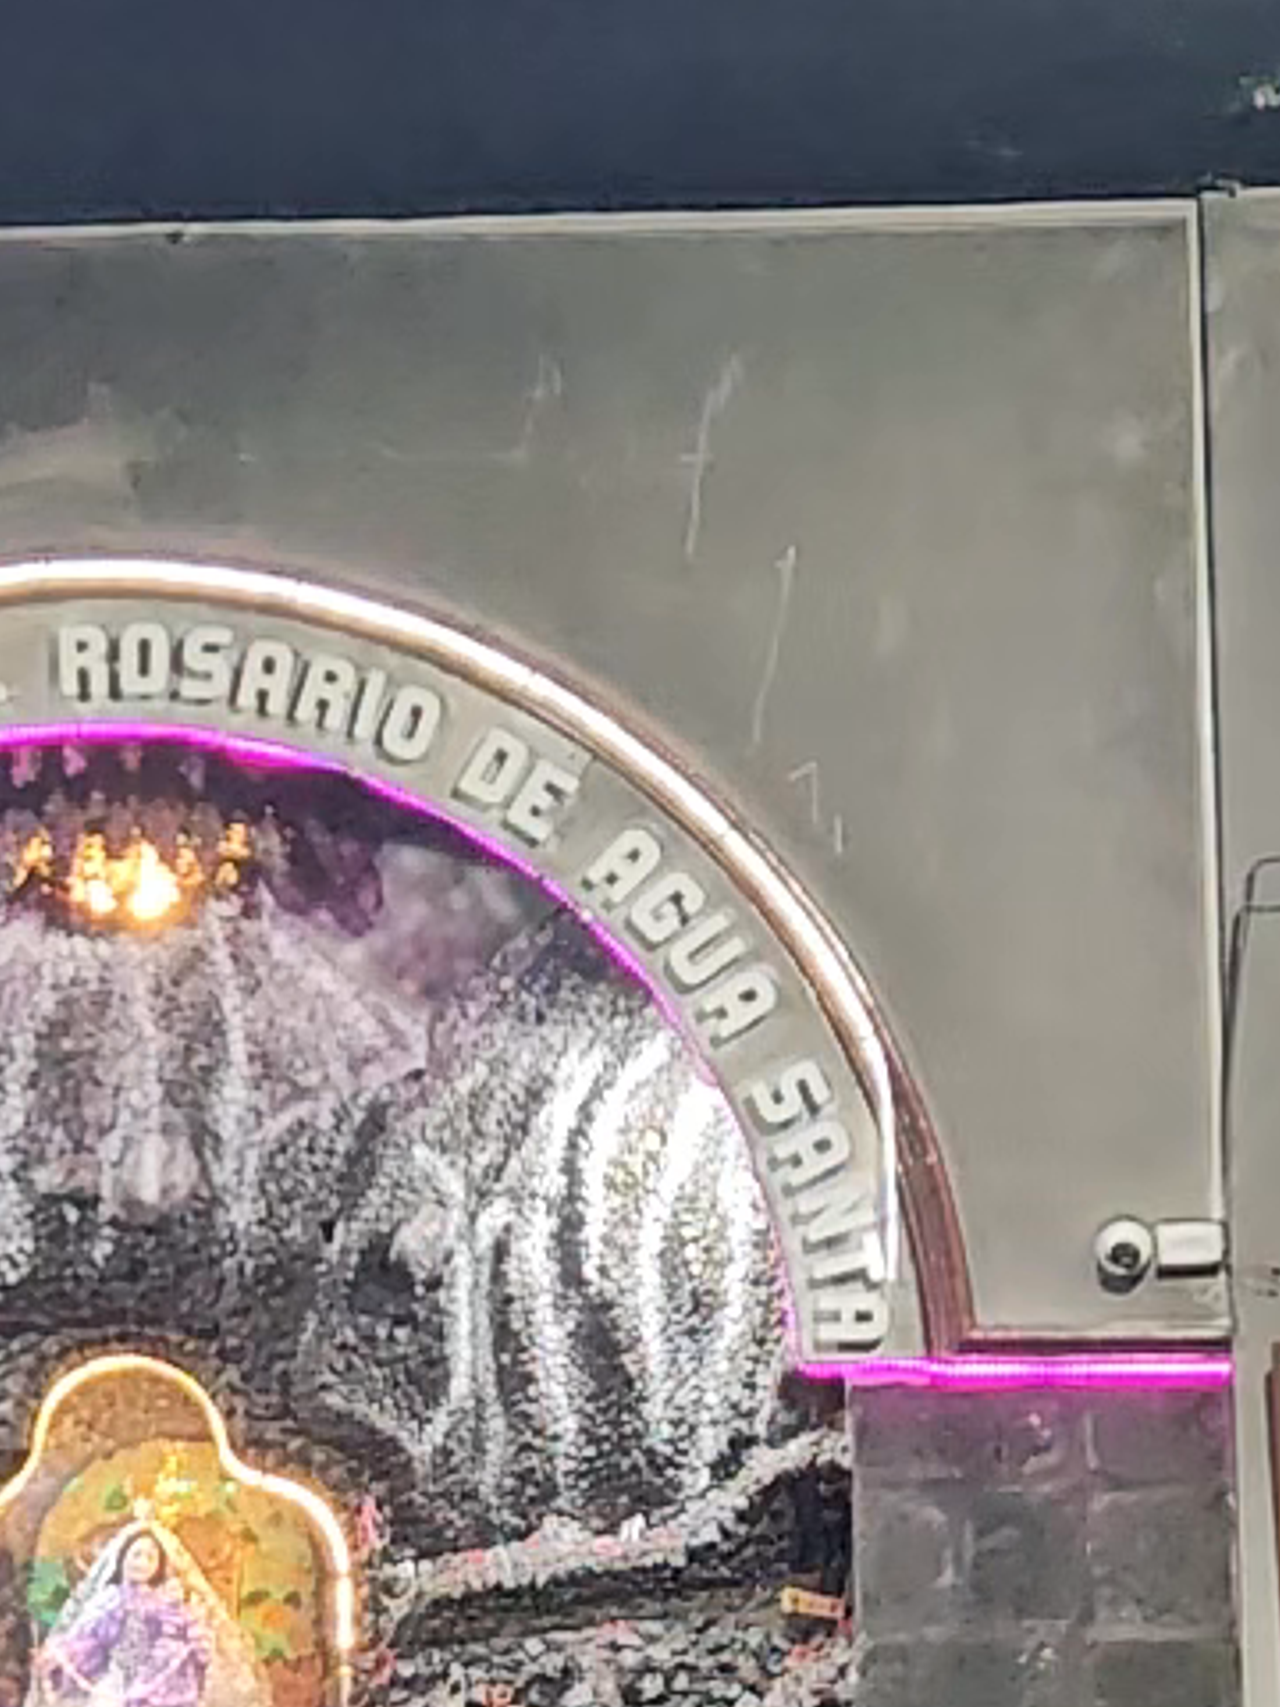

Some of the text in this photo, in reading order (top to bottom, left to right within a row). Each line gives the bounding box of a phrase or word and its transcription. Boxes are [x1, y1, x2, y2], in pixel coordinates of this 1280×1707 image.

[58, 622, 444, 761] ROSARIO
[456, 736, 580, 843] DE
[580, 827, 778, 1050] AGUA
[744, 1058, 890, 1353] SANTA
